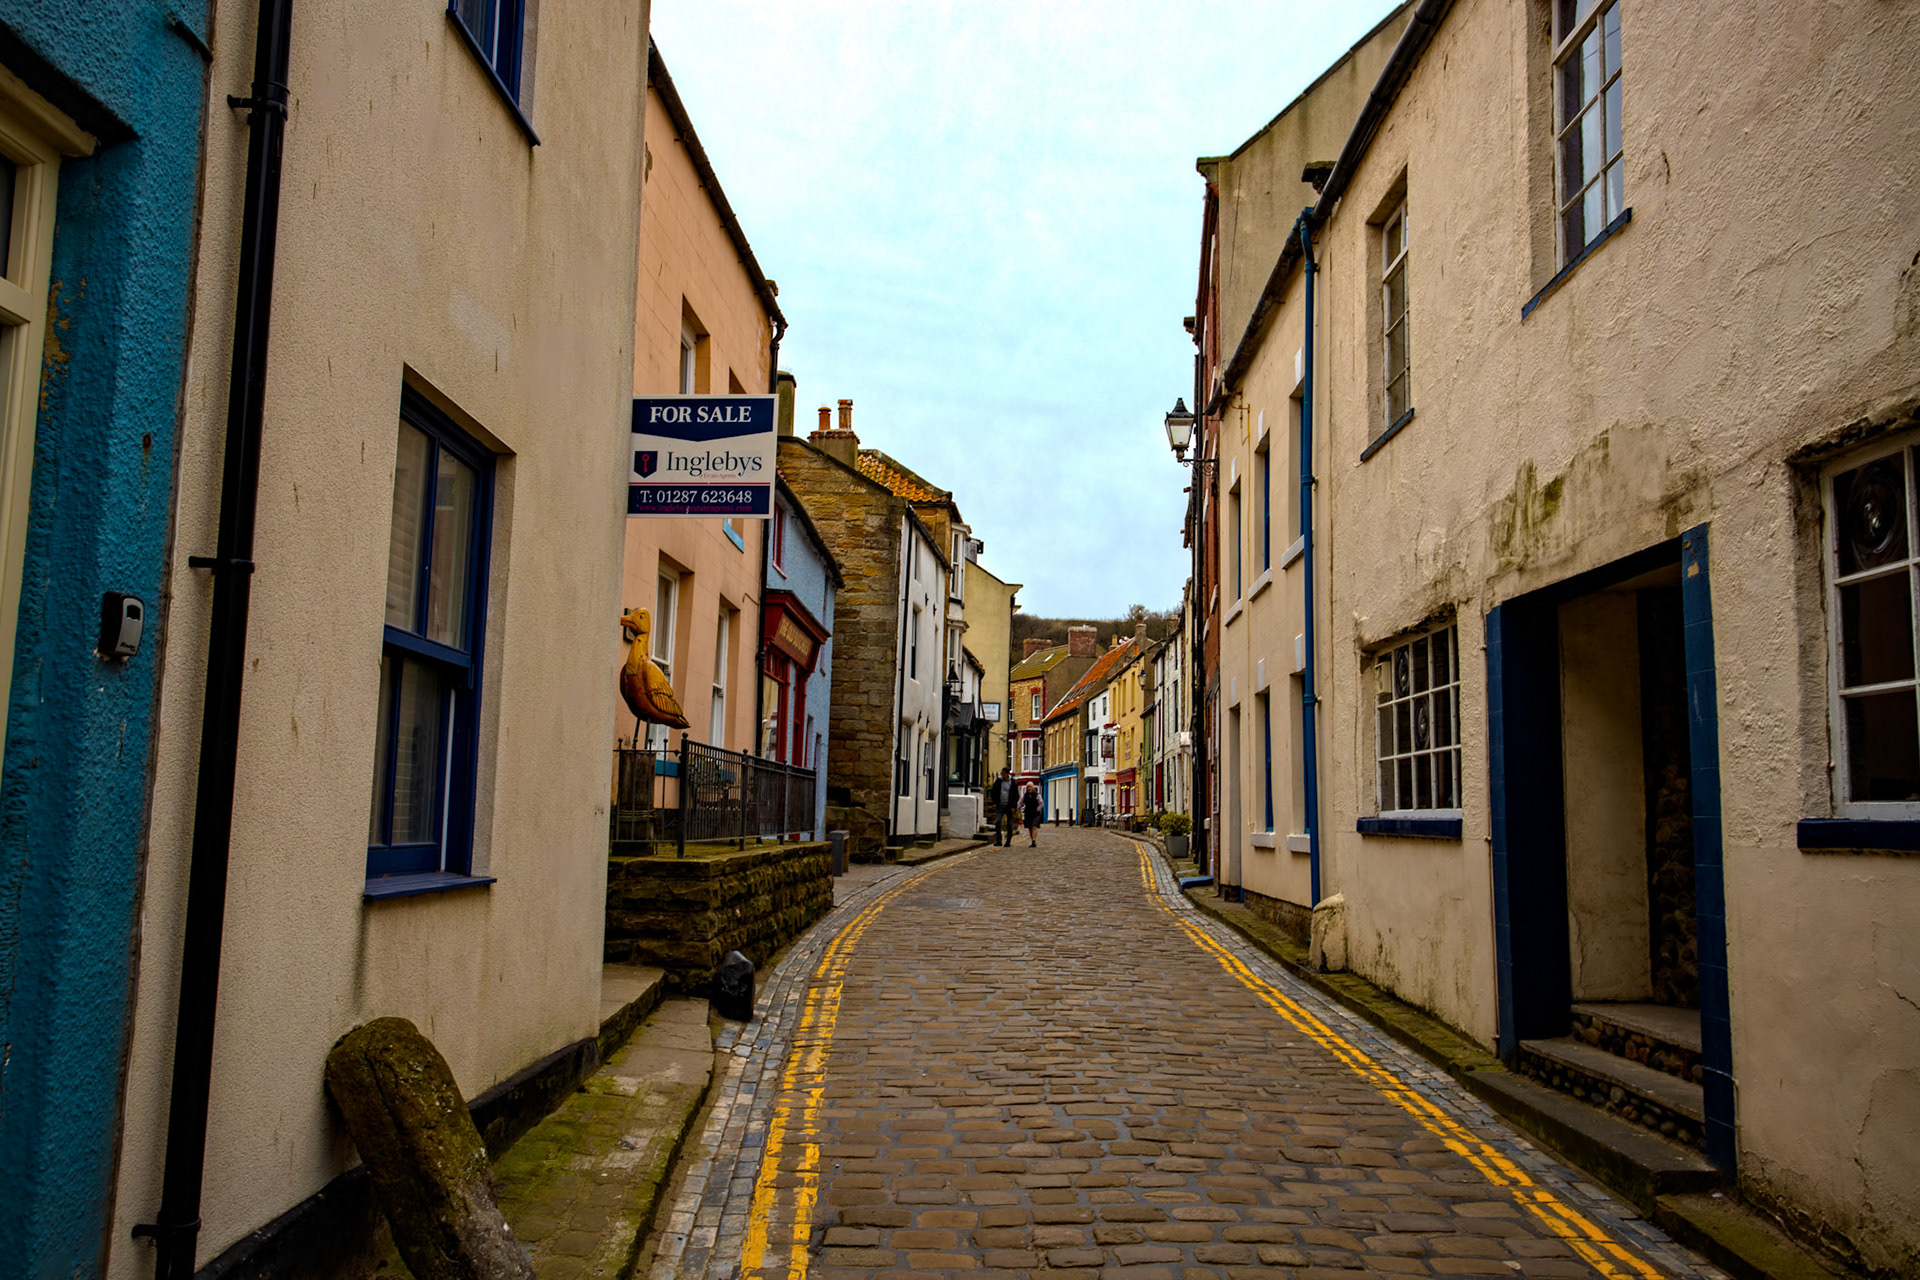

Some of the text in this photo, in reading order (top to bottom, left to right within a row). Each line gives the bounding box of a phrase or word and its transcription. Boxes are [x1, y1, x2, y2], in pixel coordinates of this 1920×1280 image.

[649, 406, 752, 423] FOR SALE
[666, 450, 762, 477] Inglebys
[640, 490, 752, 503] T: 01287 623648
